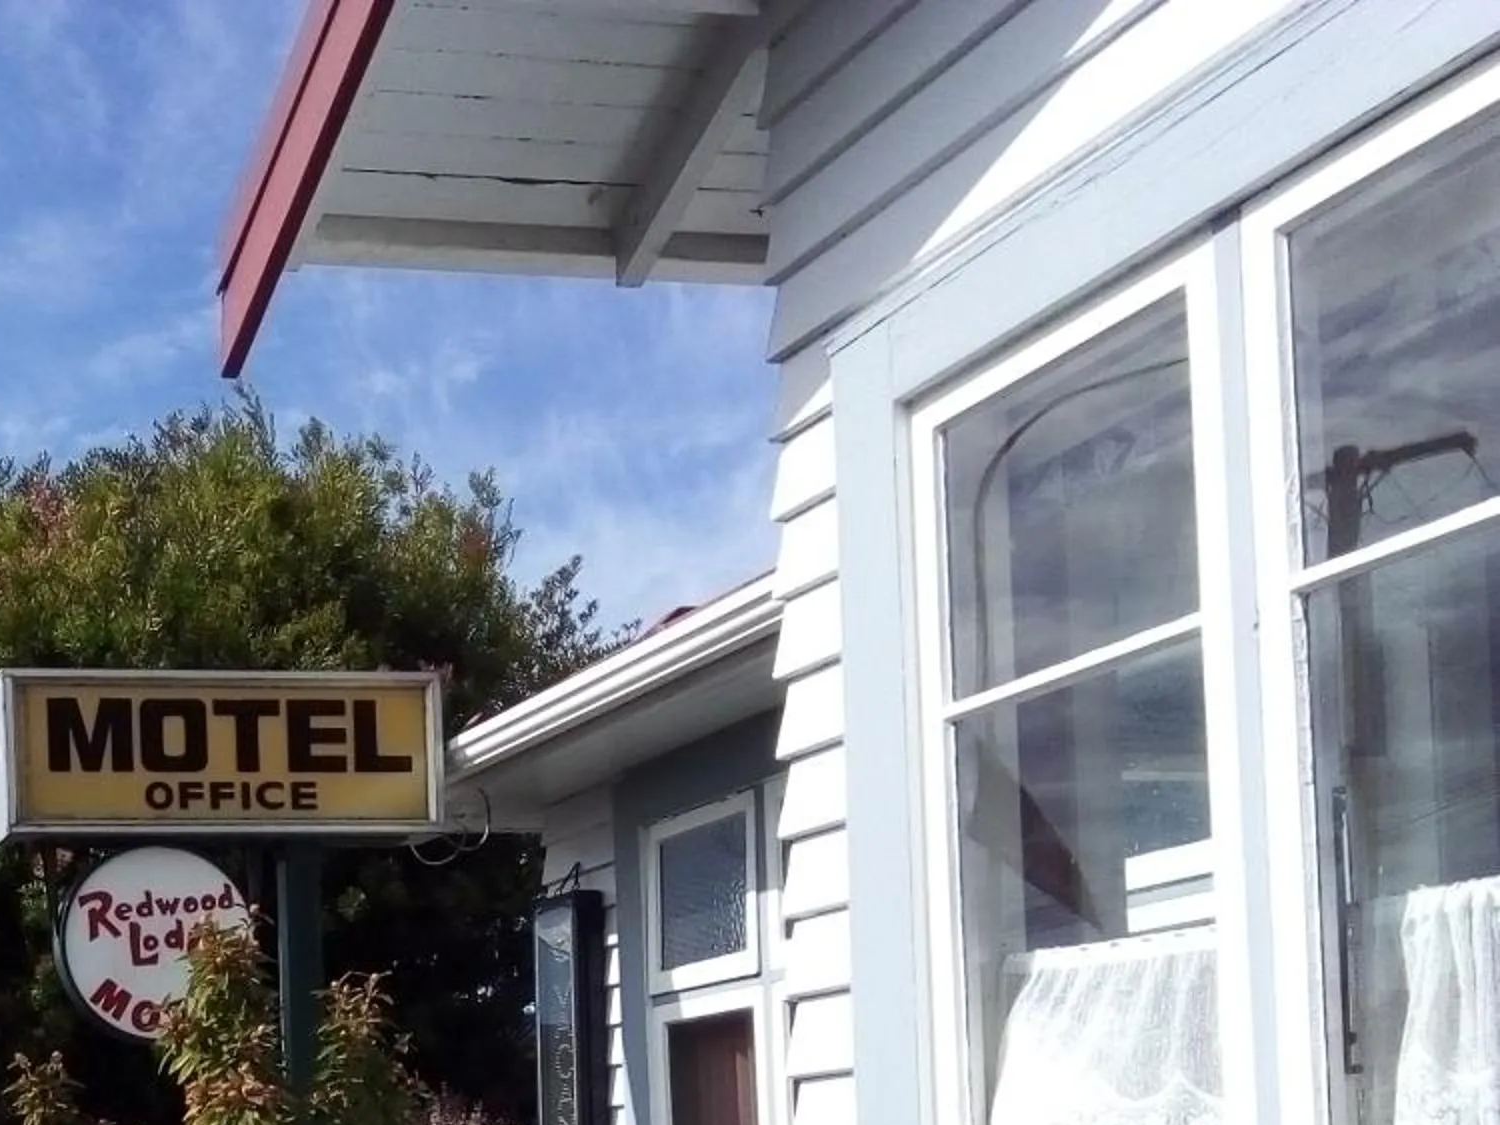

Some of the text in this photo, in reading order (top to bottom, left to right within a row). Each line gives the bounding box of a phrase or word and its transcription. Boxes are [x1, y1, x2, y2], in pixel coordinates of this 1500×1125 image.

[46, 697, 412, 773] MOTEL
[145, 781, 318, 810] OFFICE
[78, 883, 233, 942] Redwood
[129, 919, 197, 966] Lod
